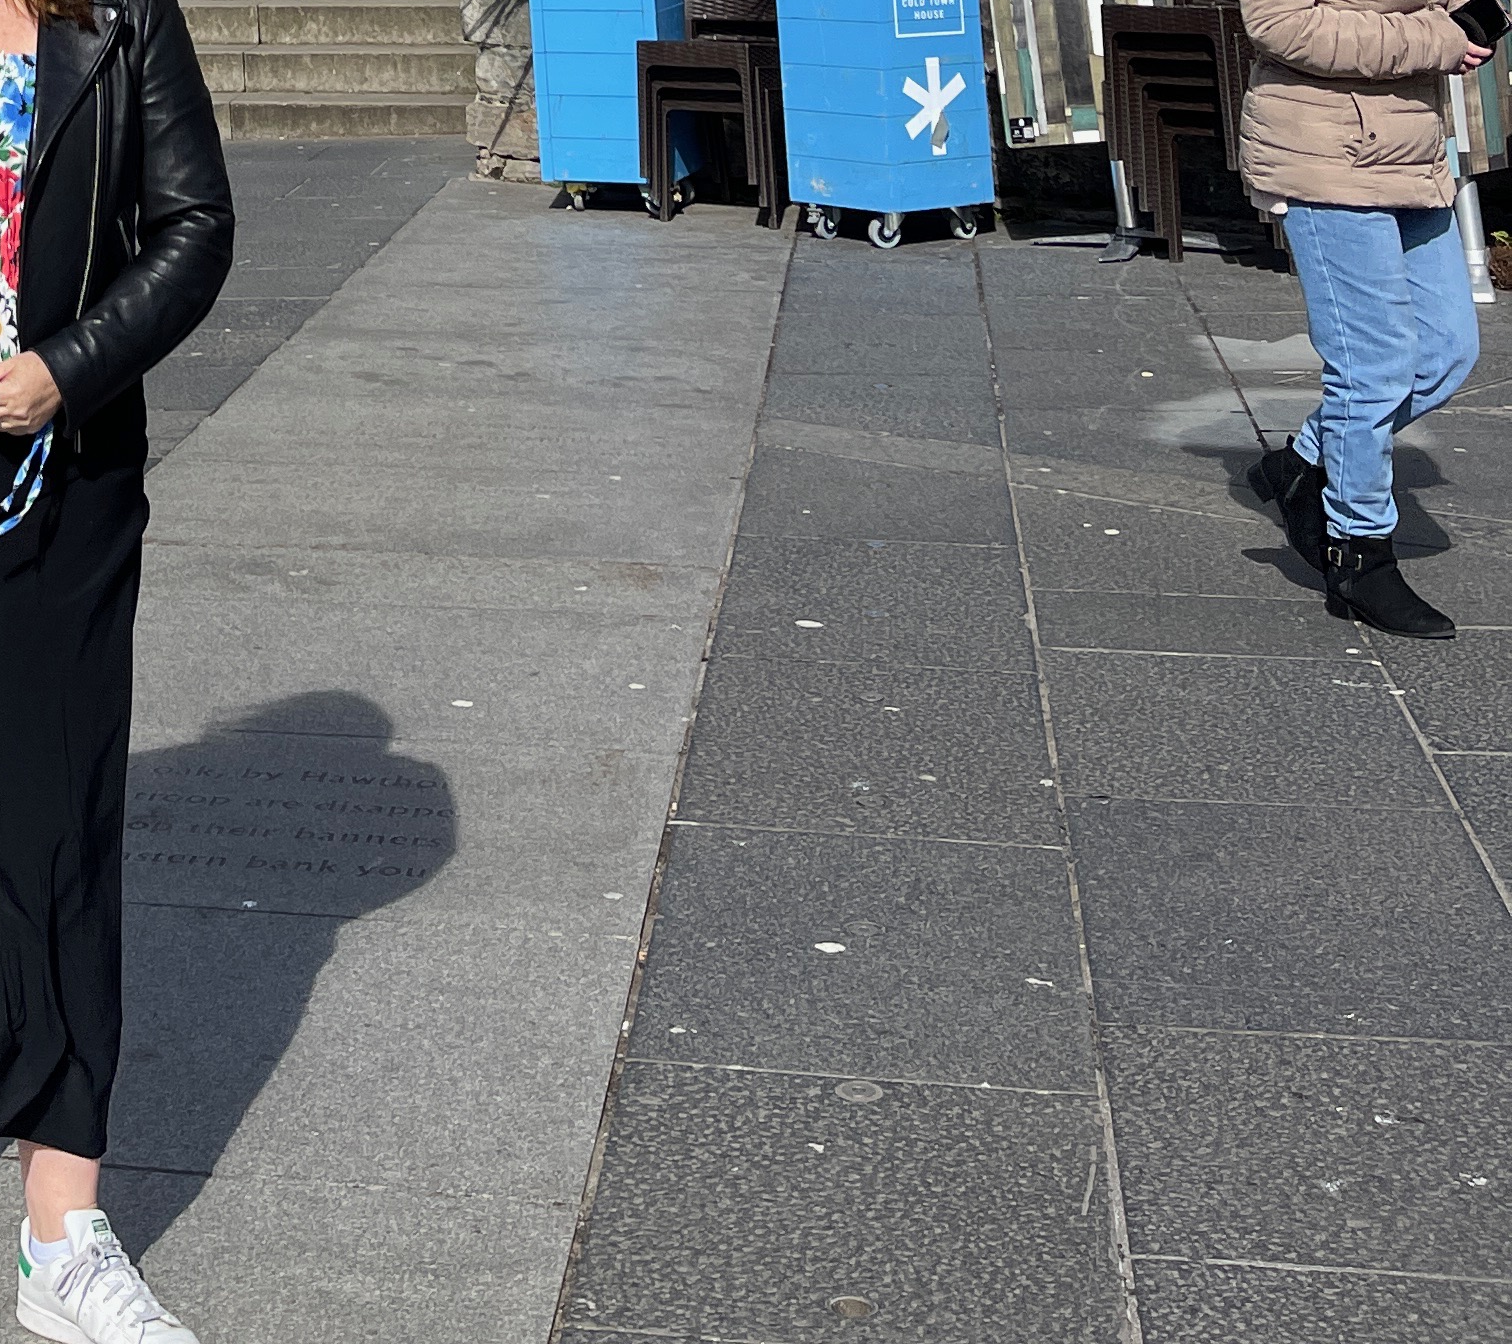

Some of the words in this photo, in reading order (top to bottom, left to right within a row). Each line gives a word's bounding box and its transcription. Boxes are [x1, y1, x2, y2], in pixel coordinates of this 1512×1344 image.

[913, 9, 945, 20] HOUSE
[241, 767, 285, 782] by
[244, 799, 305, 810] are
[190, 822, 281, 838] their
[294, 827, 442, 847] banners
[245, 855, 338, 874] bank
[356, 864, 427, 878] you
